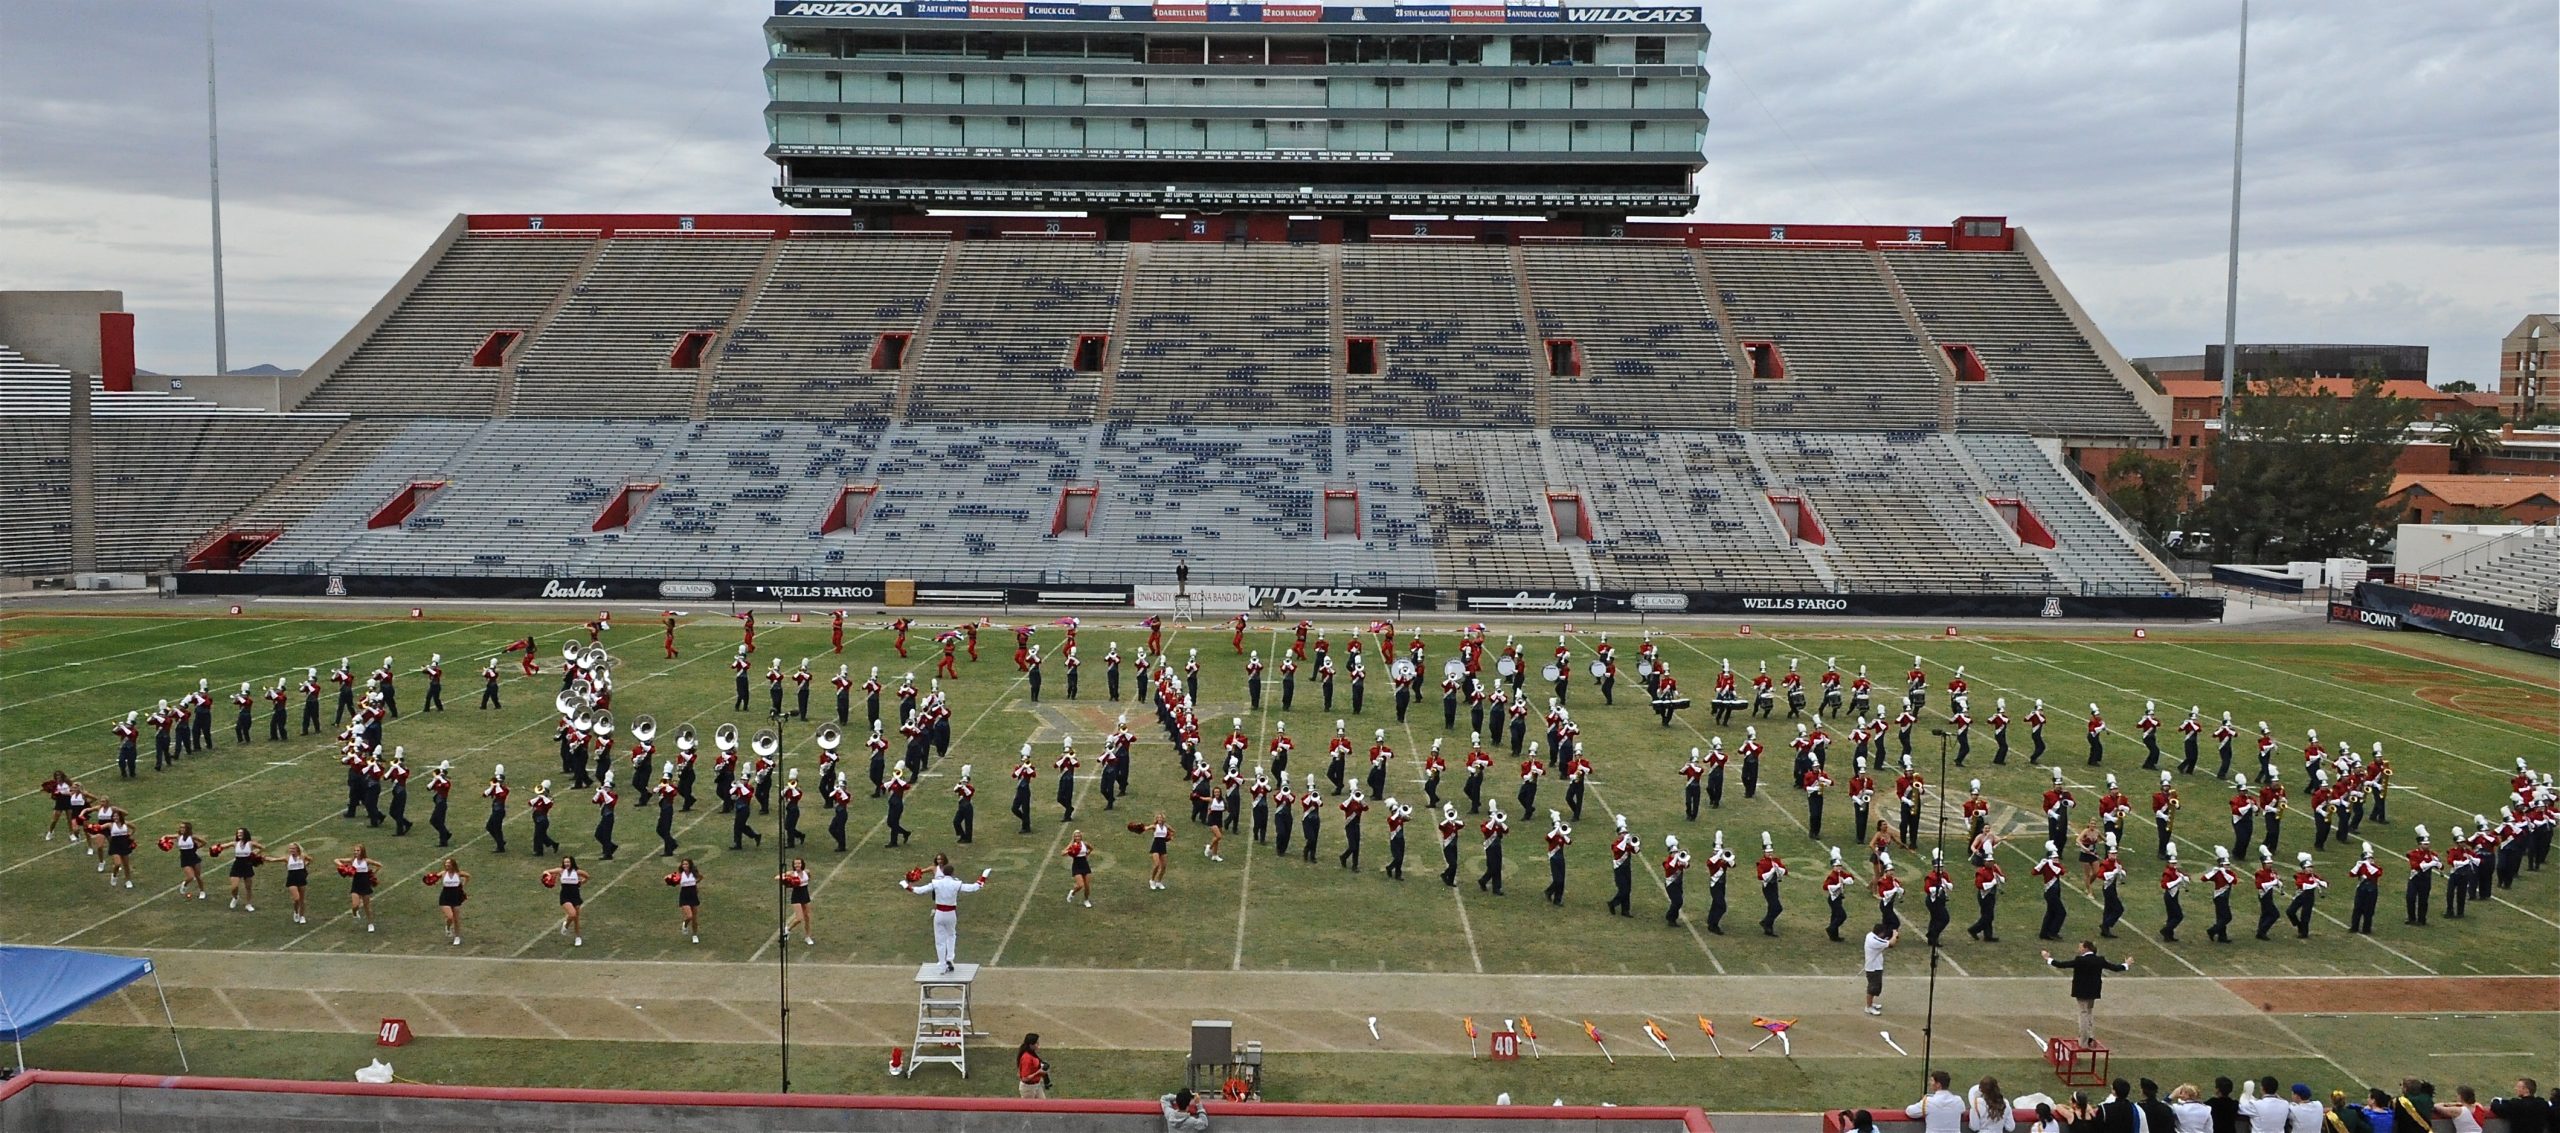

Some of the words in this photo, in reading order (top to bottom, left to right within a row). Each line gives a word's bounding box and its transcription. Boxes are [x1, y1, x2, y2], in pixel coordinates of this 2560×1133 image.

[787, 3, 903, 16] ARIZONA
[918, 5, 926, 13] 22
[939, 6, 967, 14] LUPPINO
[980, 6, 998, 14] RICKY
[999, 7, 1024, 15] HUNLEY
[1034, 7, 1056, 15] CHUCK
[1057, 7, 1076, 15] CECIL
[1159, 9, 1186, 17] DARRYLL
[1187, 9, 1206, 17] LEWIS
[1271, 9, 1285, 17] ROB
[1286, 9, 1316, 17] WALDROP
[1511, 10, 1537, 18] ANTOINE
[1538, 10, 1559, 18] CASON
[1568, 9, 1695, 22] WILDCATS
[531, 221, 542, 230] 17
[681, 222, 693, 230] 18
[853, 222, 864, 231] 19
[1046, 223, 1060, 232] 20
[1194, 224, 1205, 233] 21
[1414, 227, 1427, 236] 22
[1611, 229, 1623, 238] 23
[1771, 231, 1784, 240] 24
[1908, 233, 1921, 242] 25
[172, 380, 182, 389] 16
[541, 580, 607, 598] Bashas'
[769, 586, 820, 597] WELLS
[823, 587, 873, 598] FARGO
[1137, 592, 1171, 602] UNIVERSITY
[1186, 592, 1213, 602] RIZONA
[1213, 593, 1231, 602] BAND
[1232, 593, 1246, 602] DAY
[1742, 598, 1795, 609] WELLS
[1797, 599, 1847, 610] FARGO
[2332, 606, 2360, 621] BEAR
[2360, 613, 2396, 628] DOWN
[2449, 610, 2504, 632] FOOTBALL
[380, 1022, 400, 1043] 40
[1495, 1036, 1514, 1056] 40
